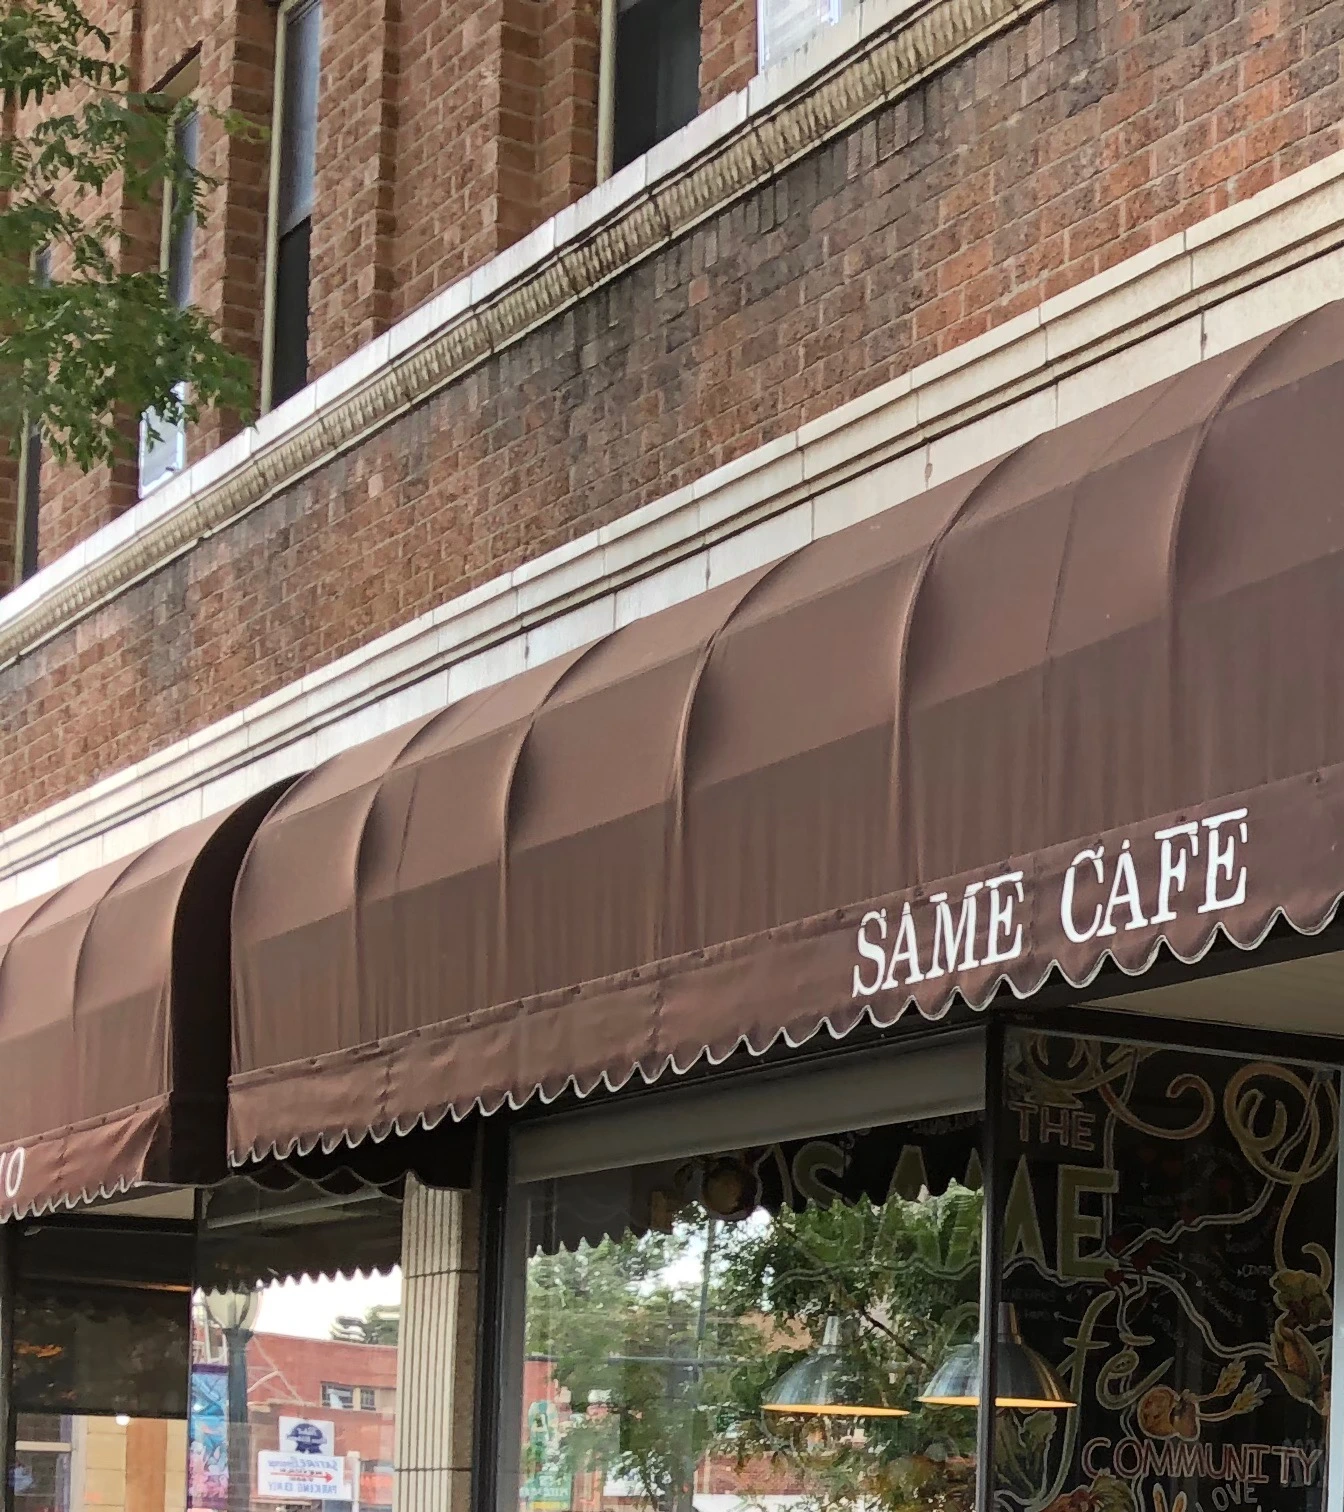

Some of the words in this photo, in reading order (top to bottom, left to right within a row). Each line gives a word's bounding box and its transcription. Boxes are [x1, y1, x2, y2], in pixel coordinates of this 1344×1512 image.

[852, 870, 1025, 998] SAME
[1060, 807, 1249, 943] CAFE
[1008, 1100, 1096, 1154] THE
[1081, 1436, 1323, 1487] COMMUNITY
